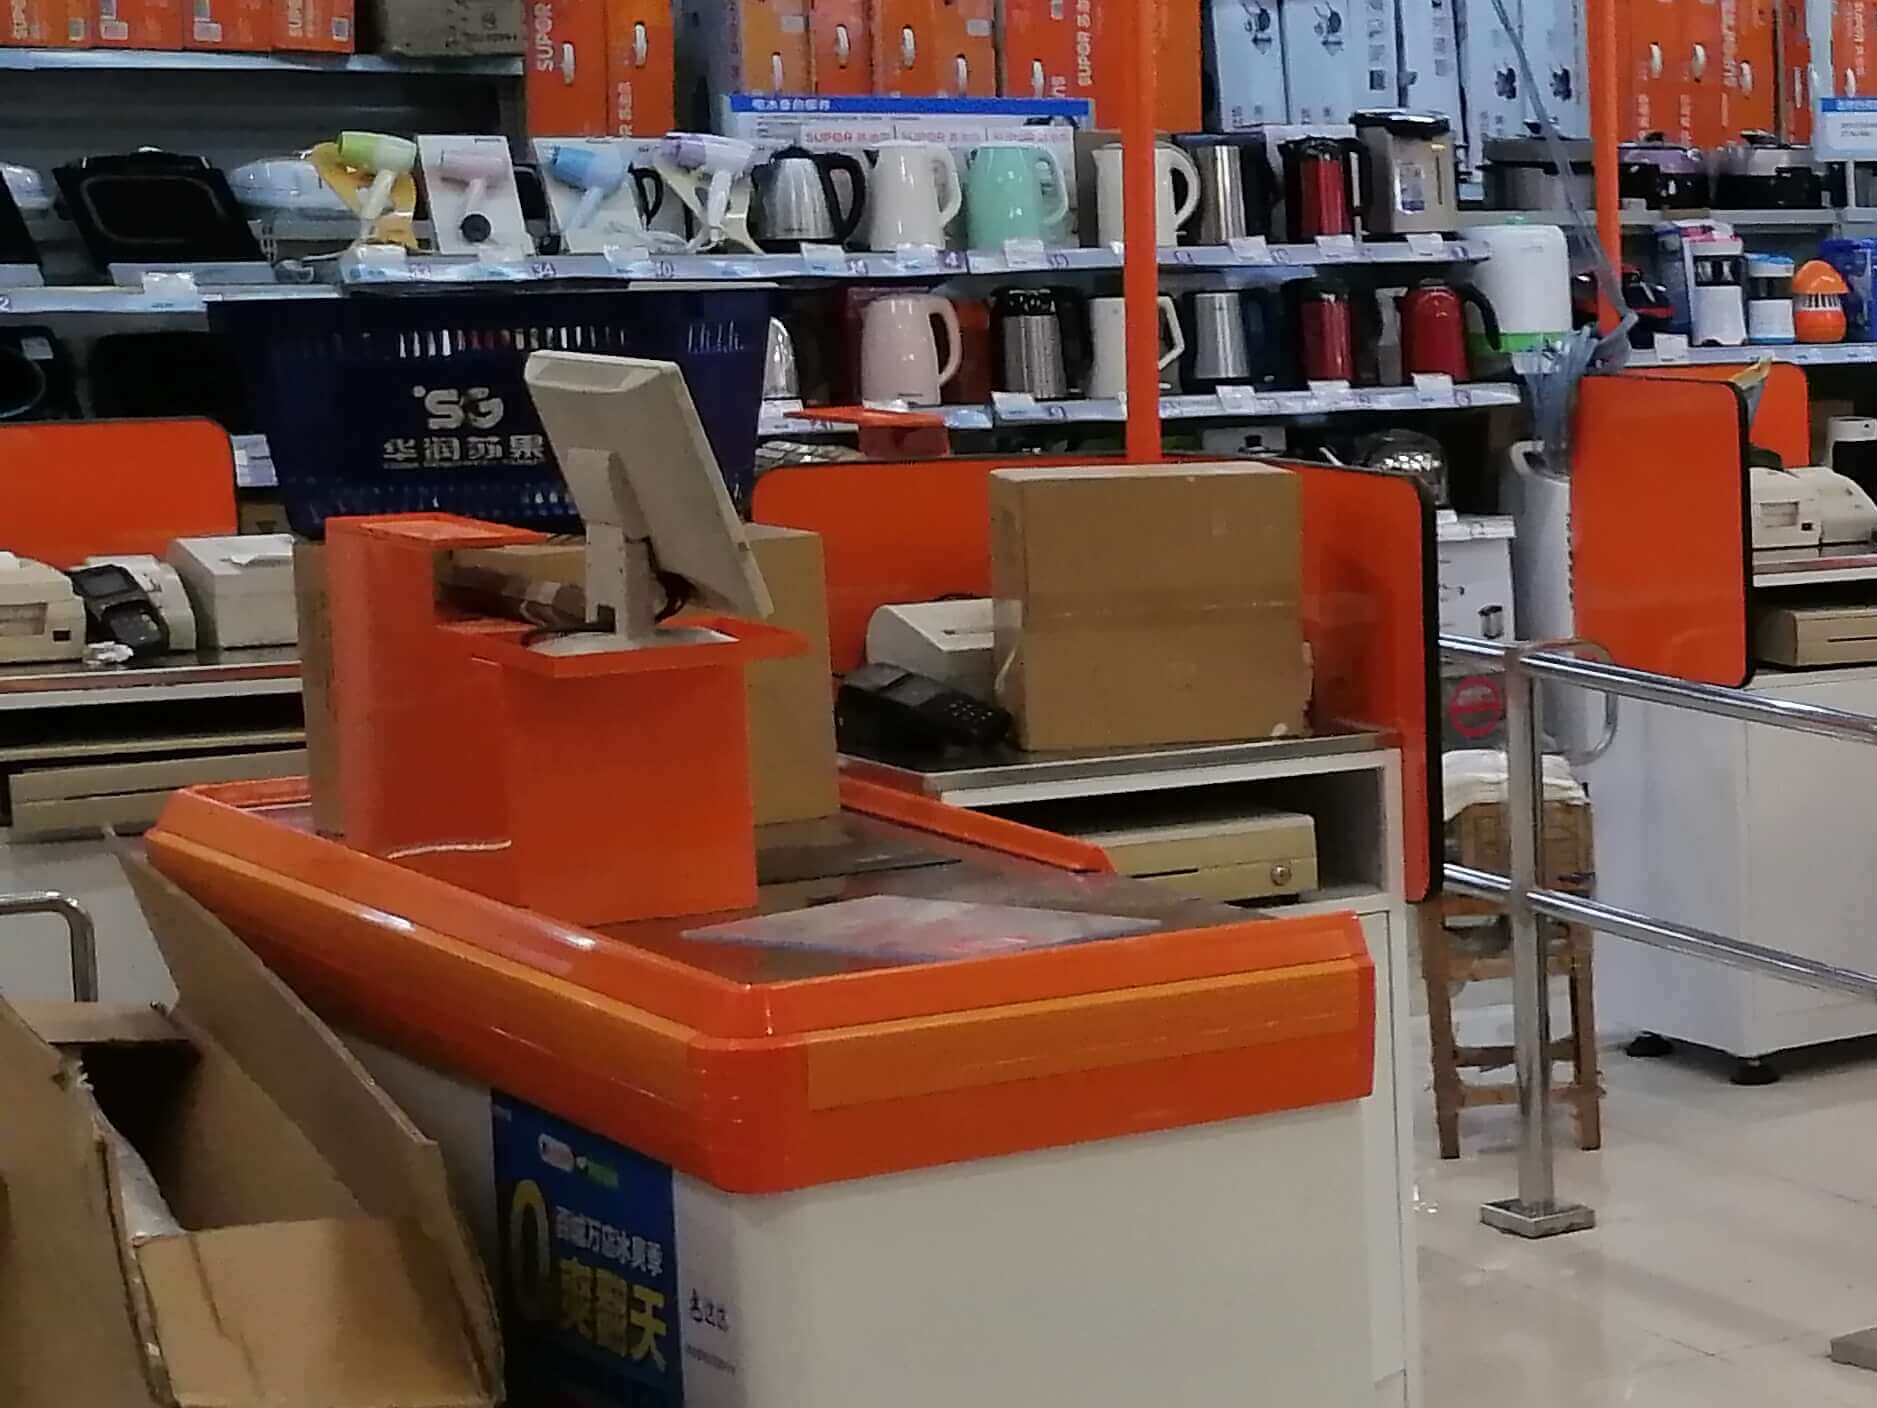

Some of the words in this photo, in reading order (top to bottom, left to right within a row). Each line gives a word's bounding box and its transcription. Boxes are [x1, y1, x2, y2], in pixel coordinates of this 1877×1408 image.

[535, 2, 554, 72] SUPOR
[424, 387, 505, 430] SG
[383, 434, 545, 461] 华润苏果
